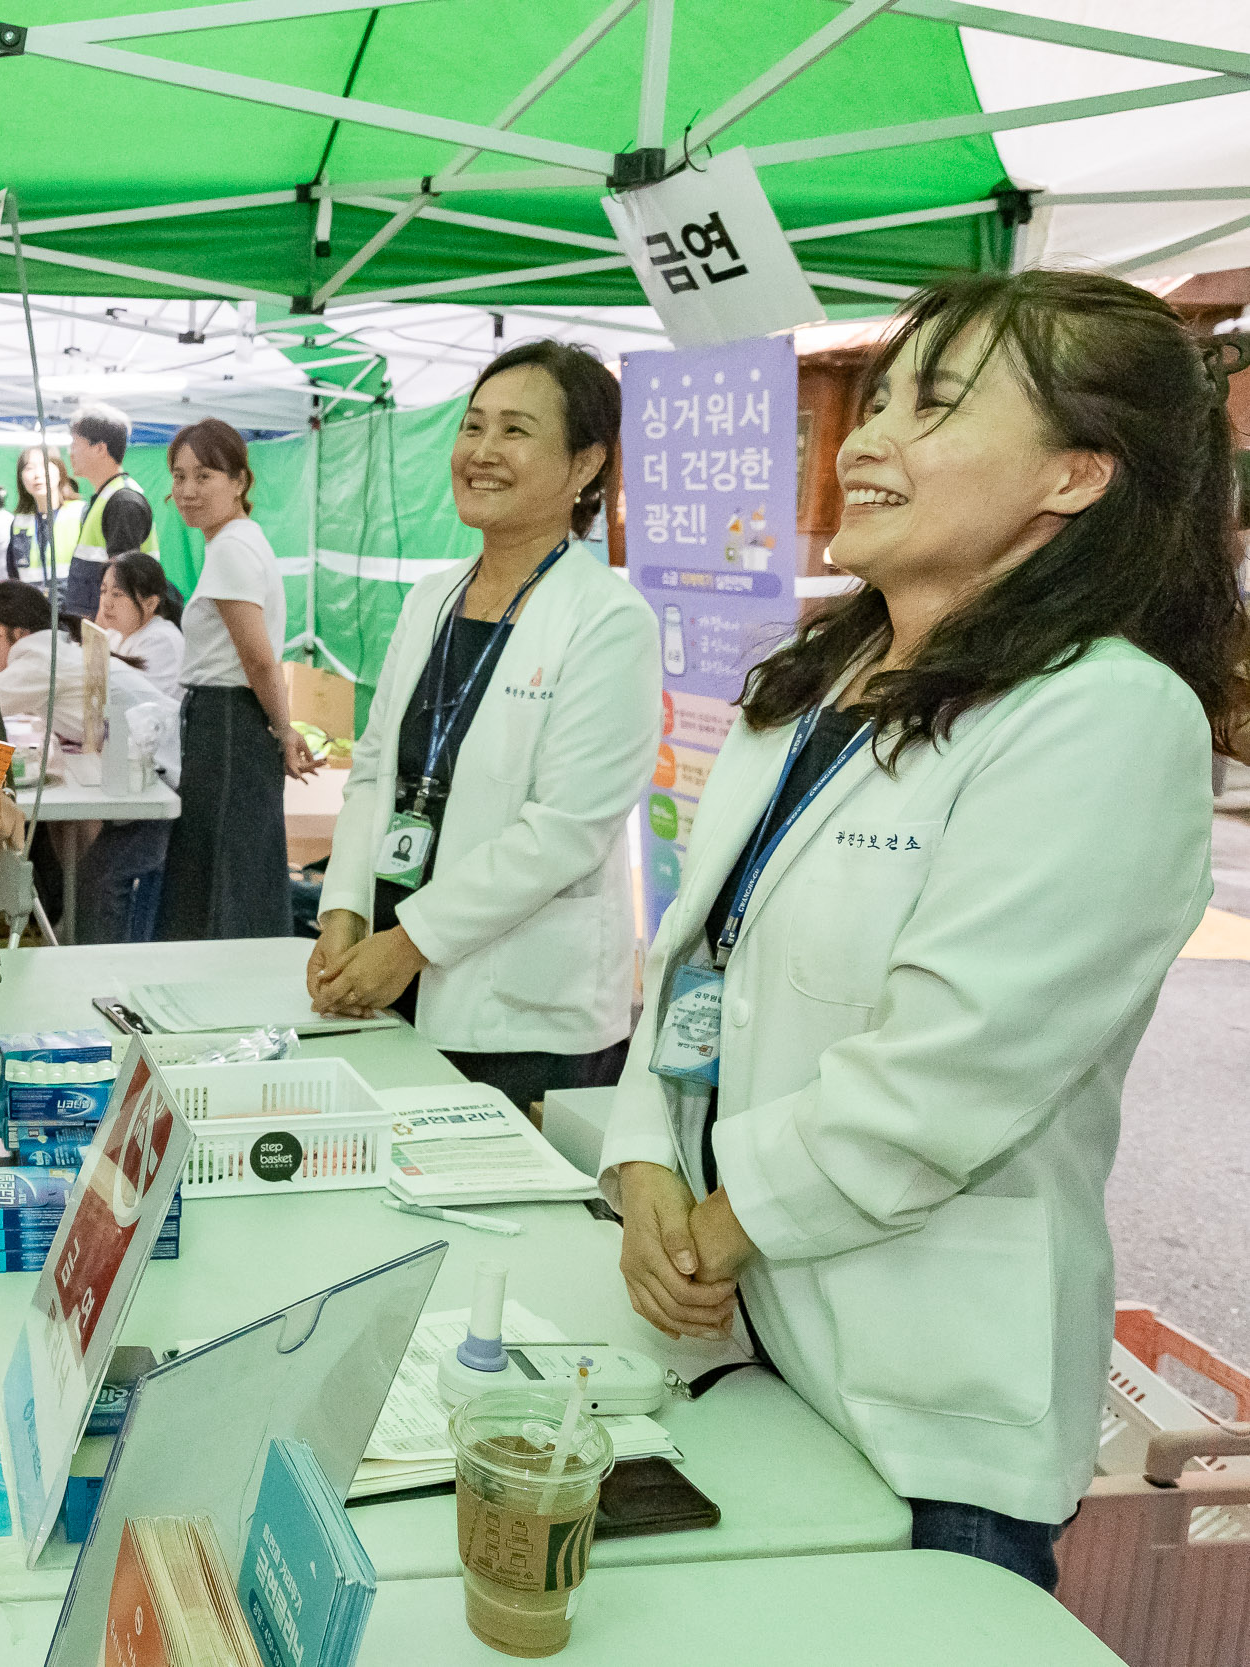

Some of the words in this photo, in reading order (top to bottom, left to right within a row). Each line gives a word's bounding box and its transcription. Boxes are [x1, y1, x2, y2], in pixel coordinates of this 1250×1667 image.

[645, 210, 750, 295] 금연
[641, 388, 770, 439] 싱거워서
[643, 450, 668, 492] 더
[680, 446, 774, 492] 건강한
[644, 502, 707, 545] 광진!
[809, 754, 847, 797] GWANGJIN-GU
[737, 868, 760, 913] GWANGJIN-GU
[259, 1153, 293, 1164] basket
[260, 1143, 284, 1153] step
